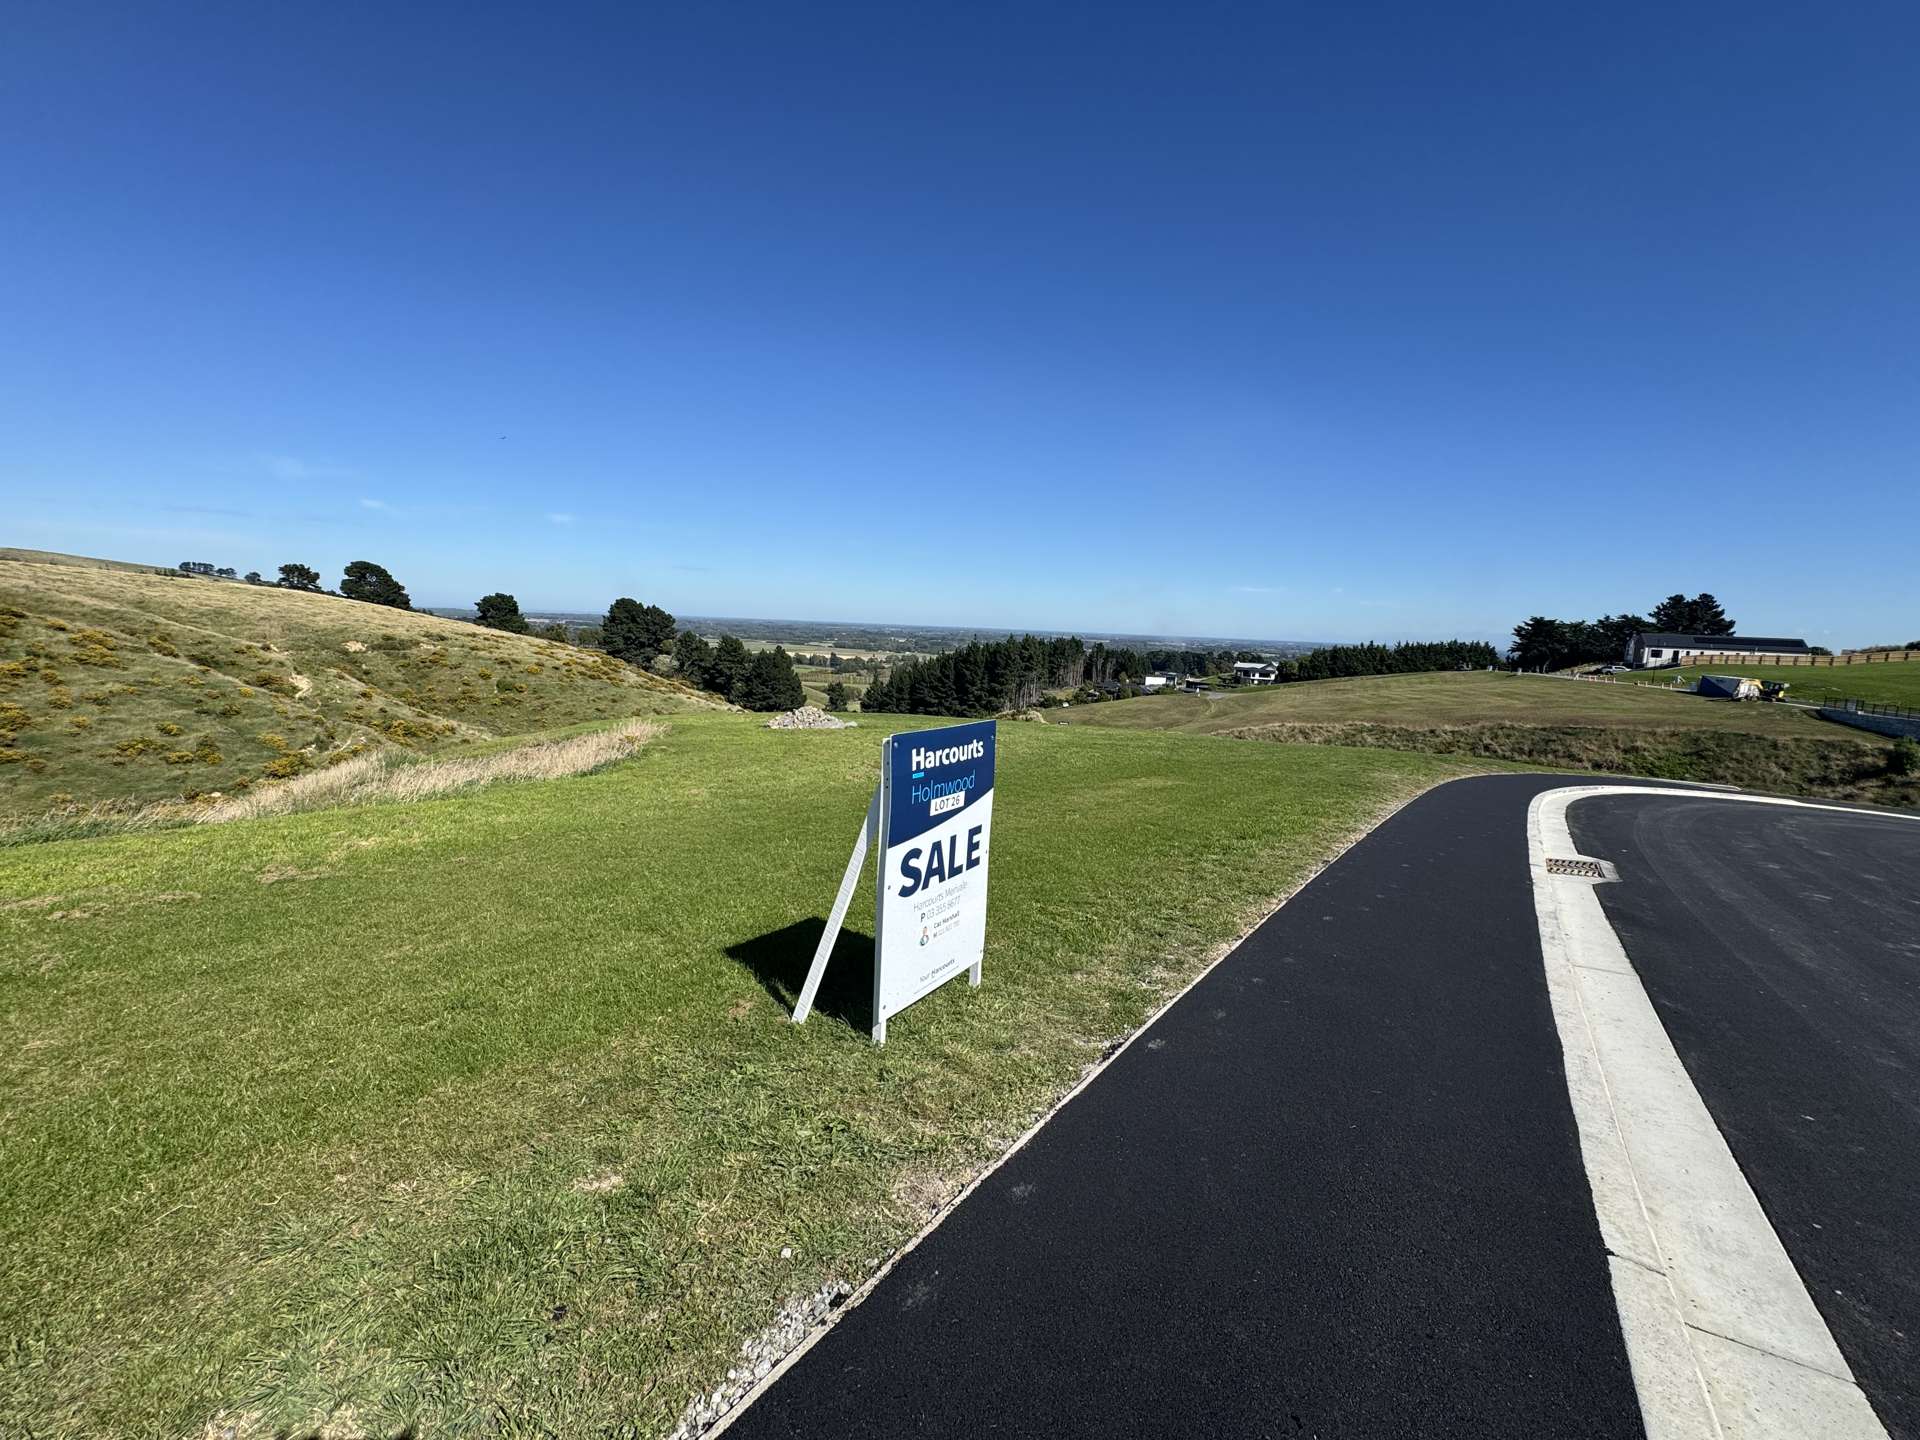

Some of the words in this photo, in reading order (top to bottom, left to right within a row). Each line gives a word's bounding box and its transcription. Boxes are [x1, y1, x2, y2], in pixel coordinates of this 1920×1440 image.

[911, 738, 984, 772] Harcourts
[911, 769, 976, 804] Holmwood
[934, 796, 950, 812] LOT
[951, 795, 961, 806] 26
[898, 823, 983, 898] SALE
